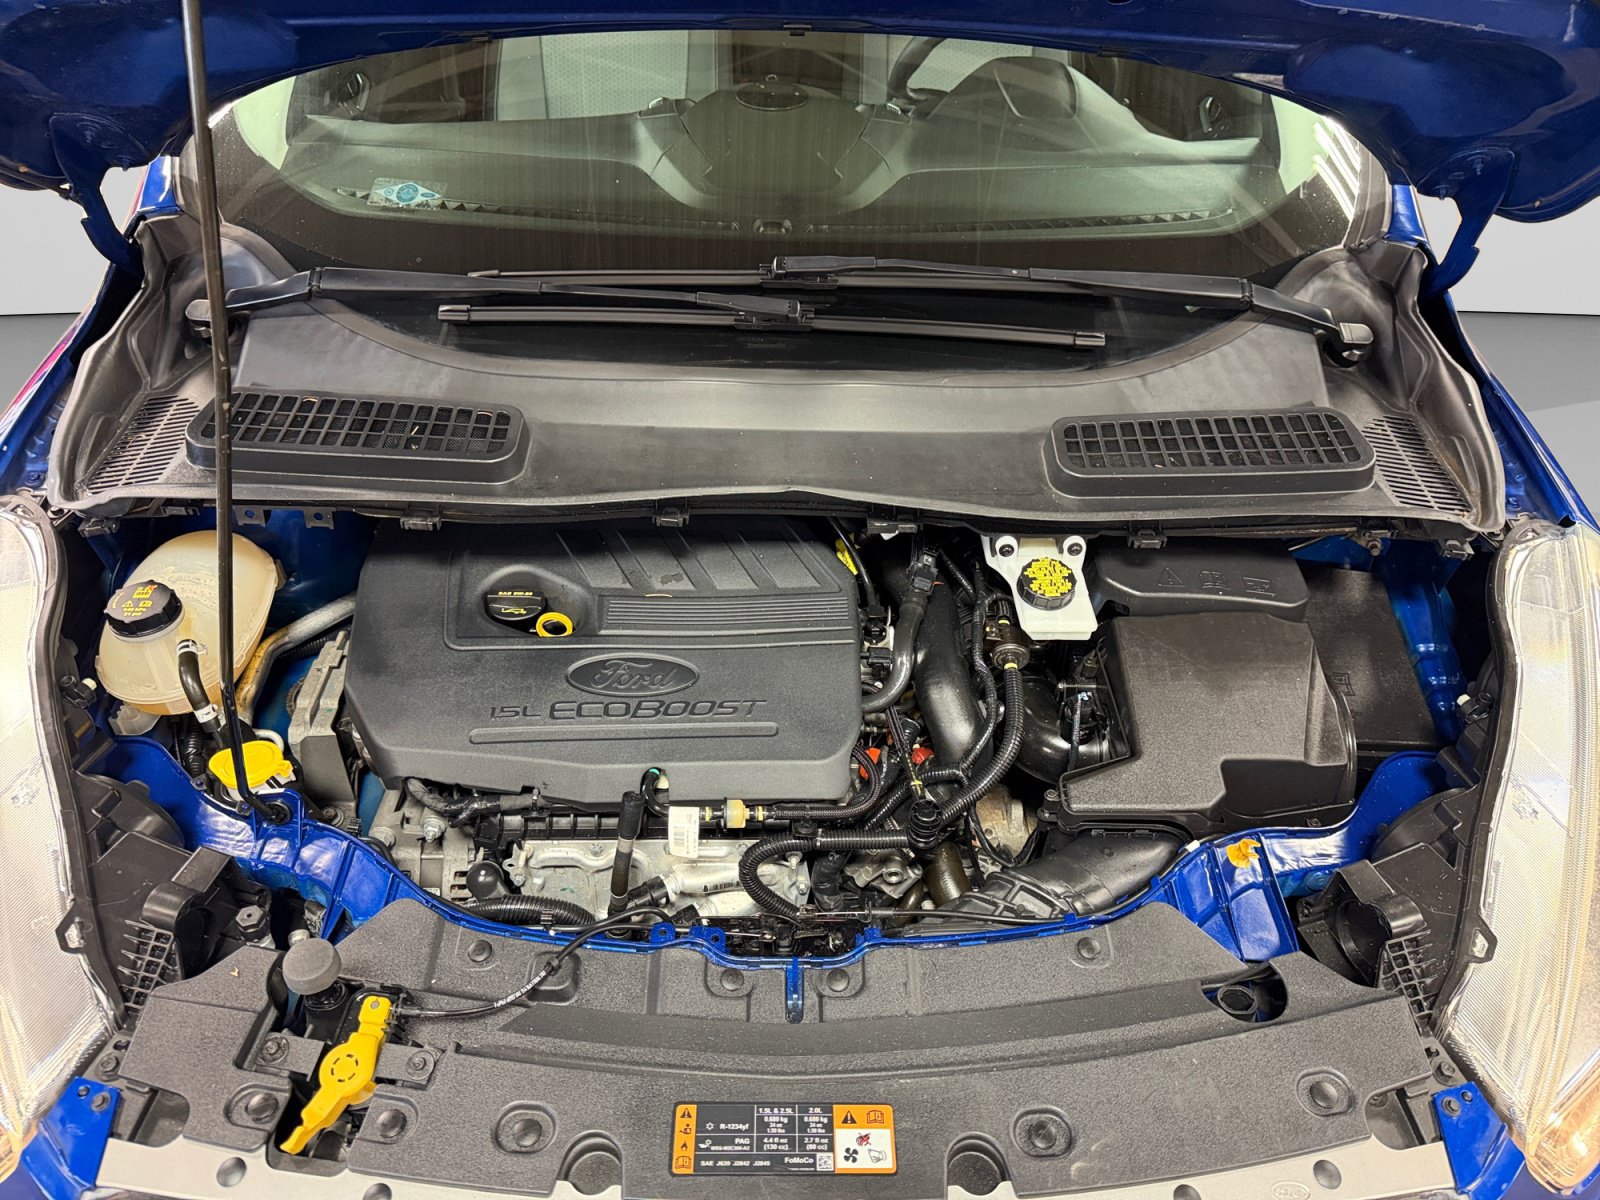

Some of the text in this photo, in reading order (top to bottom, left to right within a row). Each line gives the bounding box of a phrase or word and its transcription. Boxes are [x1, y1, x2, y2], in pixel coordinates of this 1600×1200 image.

[592, 659, 677, 689] Ford
[491, 706, 541, 720] 1.5L
[720, 1123, 749, 1131] R-1234yf
